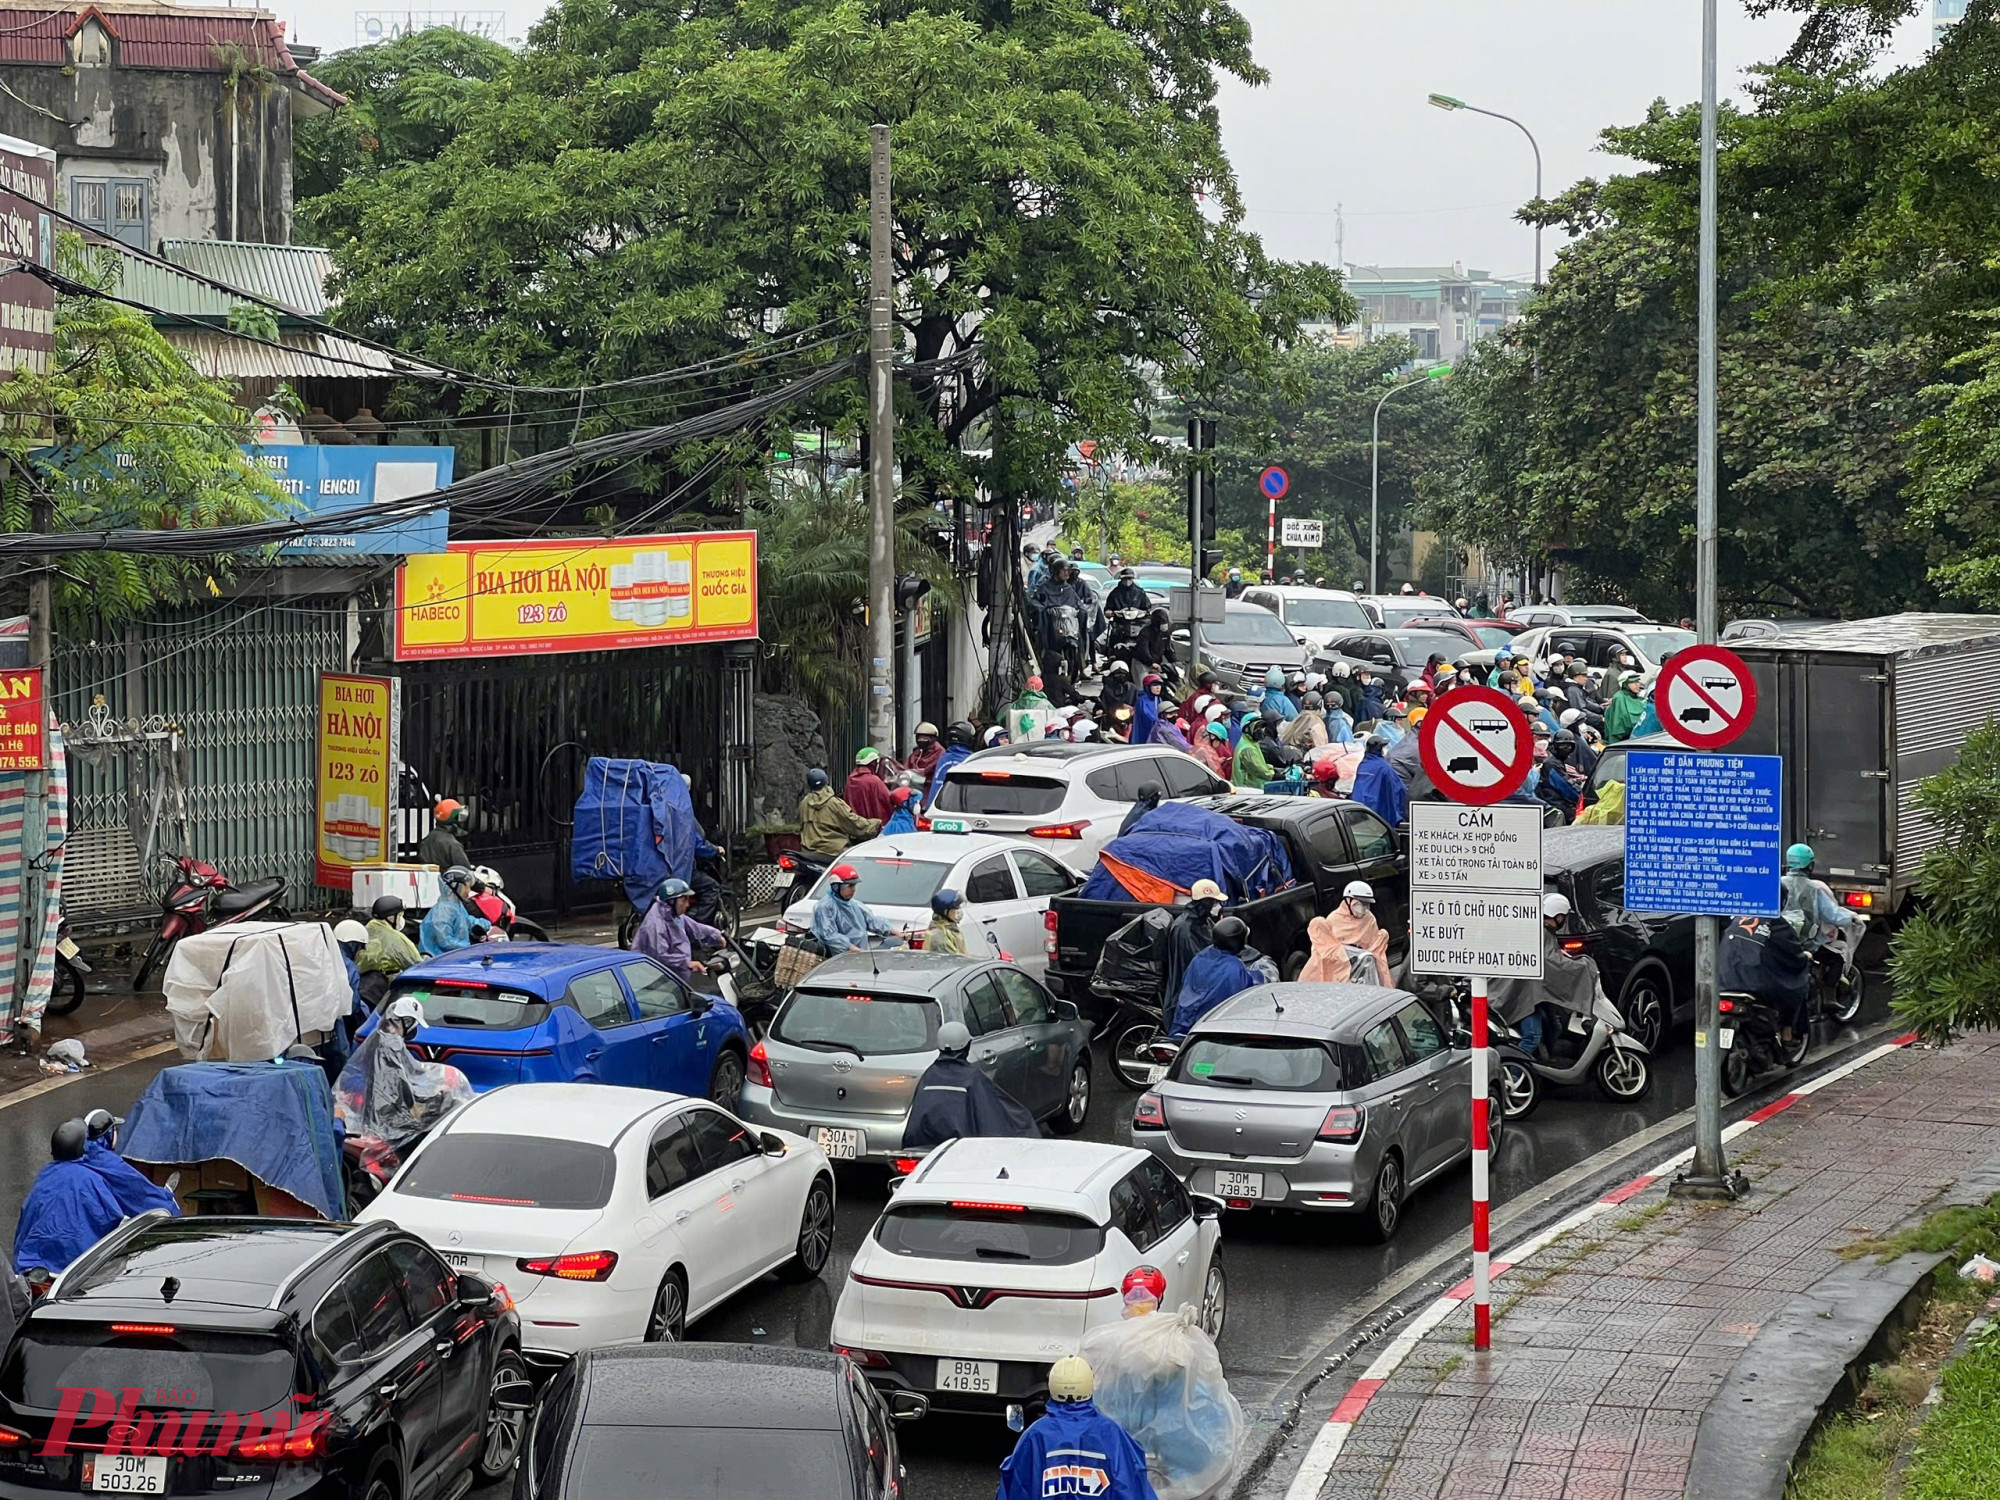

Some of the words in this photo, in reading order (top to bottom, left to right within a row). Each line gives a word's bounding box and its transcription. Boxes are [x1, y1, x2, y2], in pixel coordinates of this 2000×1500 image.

[477, 572, 507, 595] BIA
[511, 568, 544, 592] HƠI
[547, 562, 574, 591] HÀ
[577, 563, 606, 599] NỘI
[702, 582, 725, 596] QUỐC
[728, 584, 747, 595] GIA
[411, 605, 460, 622] HABECO
[518, 604, 544, 624] 123
[335, 686, 352, 702] BIA
[355, 688, 374, 704] HƠI
[327, 708, 350, 736] HÀ
[354, 712, 382, 744] NỘI
[19, 756, 38, 768] 555
[328, 762, 354, 781] 123
[1458, 808, 1493, 827] CẤM
[937, 822, 958, 830] Grab
[1463, 832, 1472, 840] XE
[1431, 844, 1442, 853] DU
[1444, 845, 1462, 855] LỊCH
[1472, 846, 1476, 854] 9
[1446, 856, 1456, 867] CÓ
[1502, 858, 1524, 869] TOÀN
[1419, 871, 1429, 880] XE
[1438, 872, 1450, 880] 0.5
[1452, 869, 1468, 880] TẤN
[1438, 900, 1444, 915] Ô
[1448, 900, 1460, 916] TÔ
[1464, 900, 1484, 916] CHỞ
[1488, 905, 1509, 920] HỌC
[1512, 906, 1537, 919] SINH
[1438, 924, 1464, 940] BUÝT
[1417, 949, 1445, 965] ĐƯỢC
[1449, 948, 1475, 964] PHÉP
[1478, 952, 1504, 968] HOẠT
[1508, 951, 1537, 969] ĐỘNG
[827, 1130, 847, 1143] 30A
[819, 1143, 854, 1158] 31.70
[1229, 1173, 1249, 1184] 30M
[1220, 1184, 1256, 1196] 738.35
[955, 1362, 978, 1375] 89A
[943, 1376, 988, 1390] 418.95
[115, 1457, 146, 1473] 30M
[101, 1474, 156, 1491] 503.26
